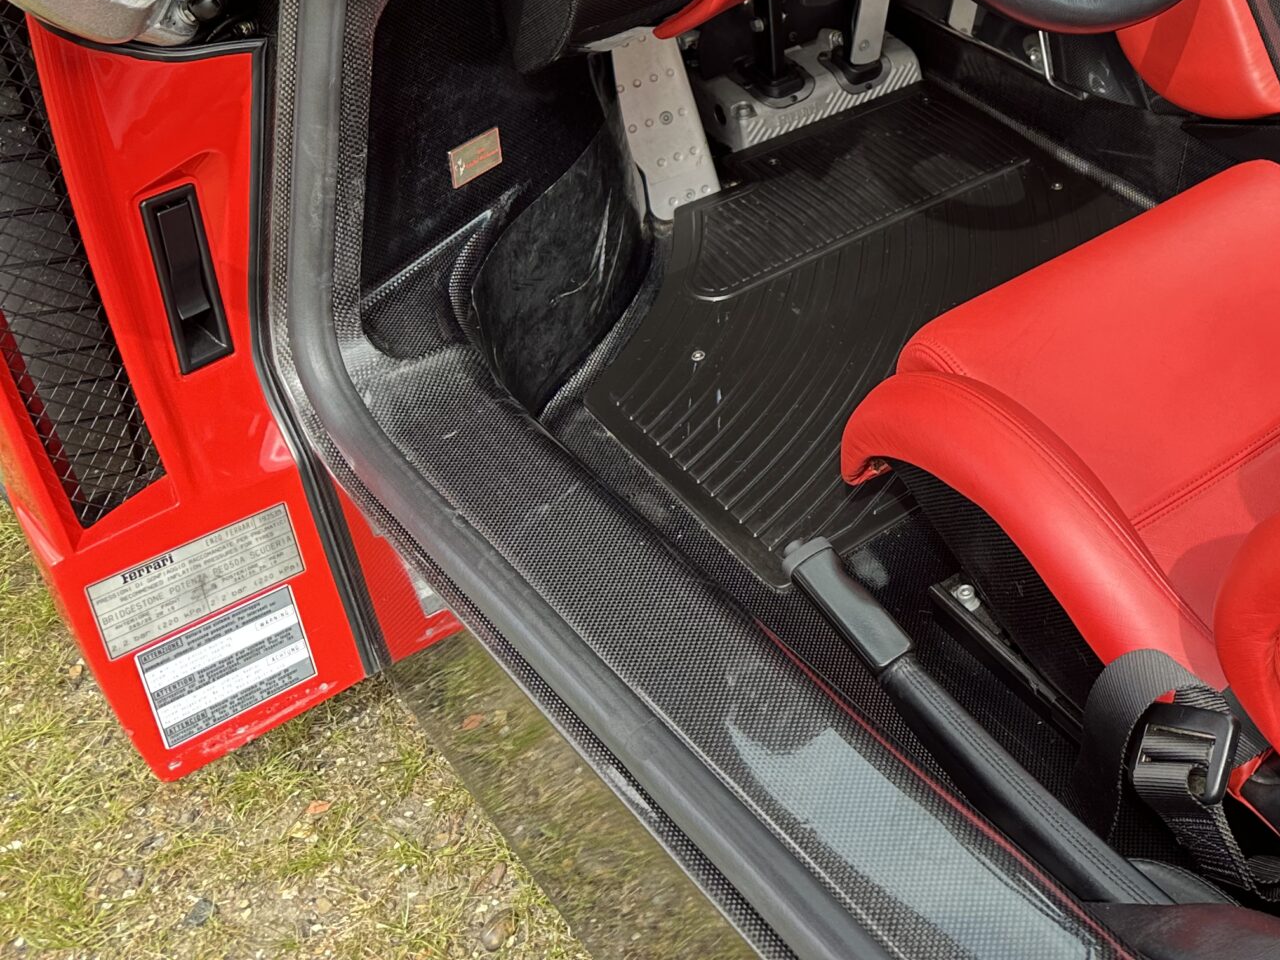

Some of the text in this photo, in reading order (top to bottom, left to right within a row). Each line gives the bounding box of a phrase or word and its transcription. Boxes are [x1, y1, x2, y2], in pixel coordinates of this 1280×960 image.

[118, 552, 175, 585] Ferrari
[224, 518, 255, 539] FERRARI
[100, 590, 166, 626] BRIDGESTONE
[167, 570, 209, 596] POTENZA
[248, 533, 292, 560] SCUDERIA
[230, 584, 248, 598] bar
[258, 609, 290, 628] WARNING
[131, 628, 151, 643] bar
[142, 640, 181, 663] ATTENZIONE
[270, 644, 300, 663] ACHTUNG
[154, 674, 194, 698] ATTENTION
